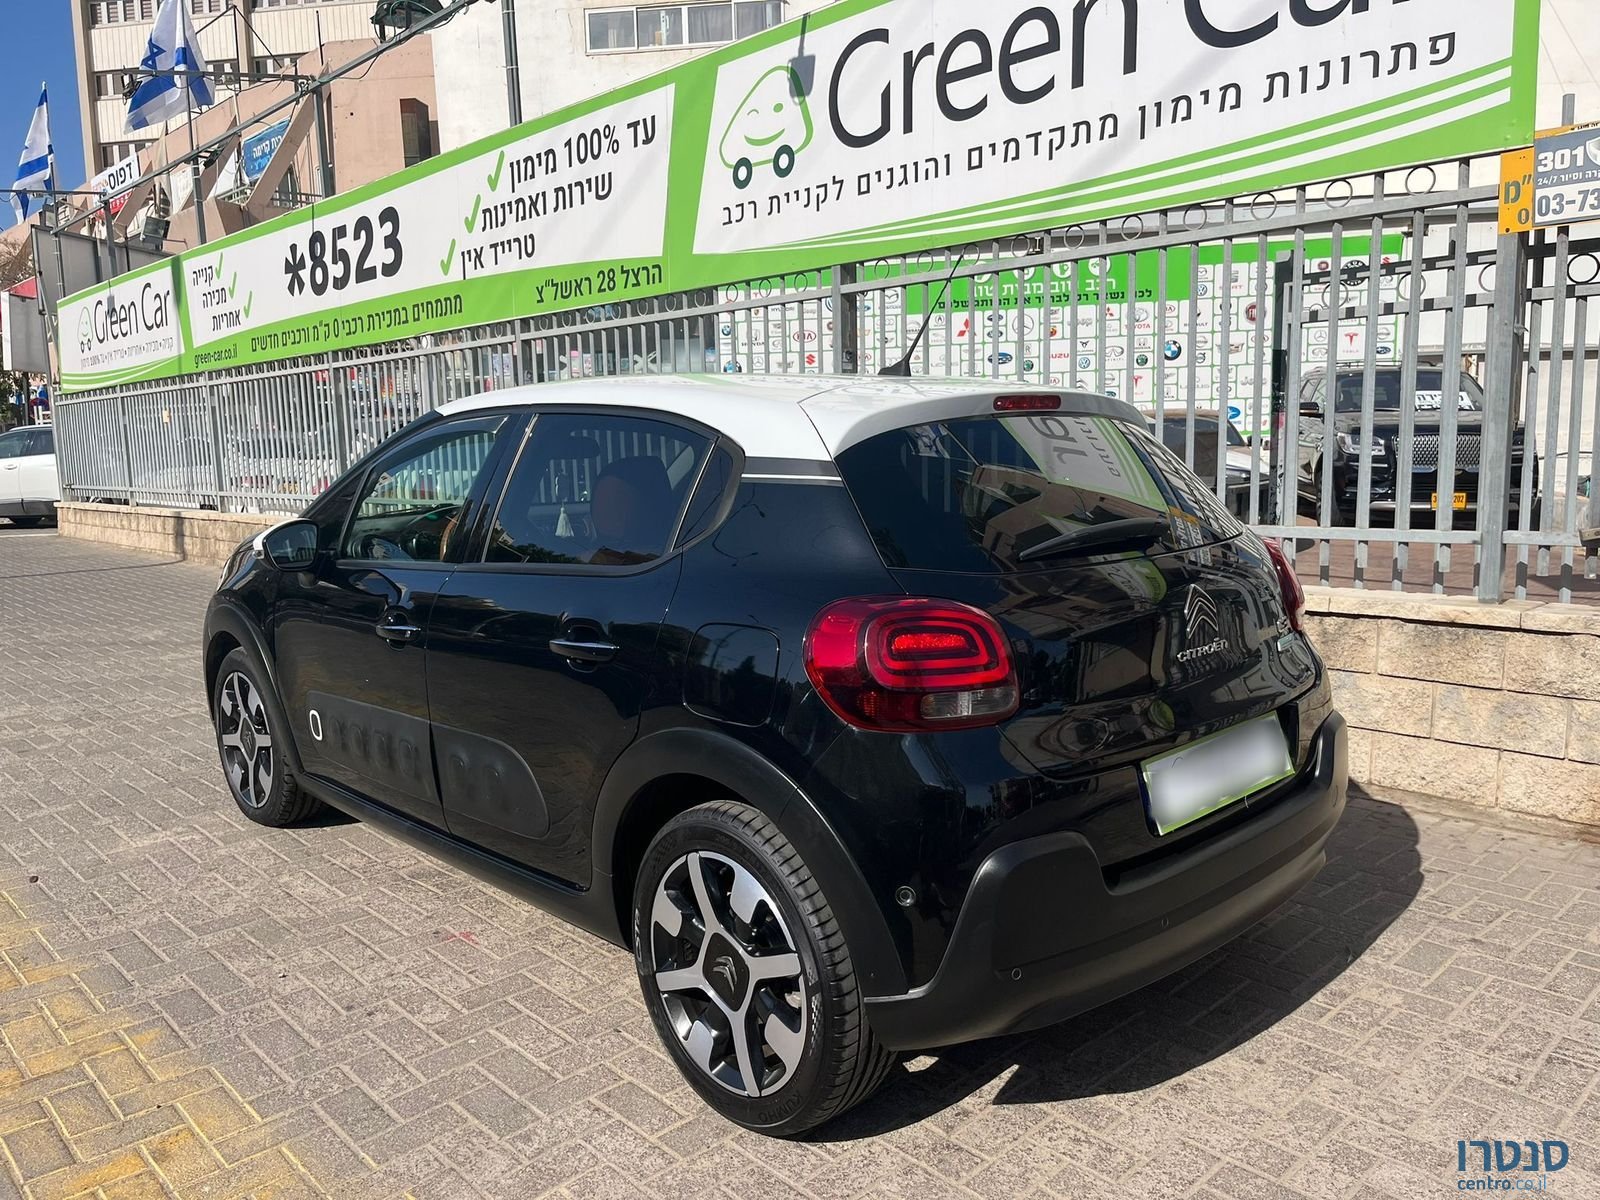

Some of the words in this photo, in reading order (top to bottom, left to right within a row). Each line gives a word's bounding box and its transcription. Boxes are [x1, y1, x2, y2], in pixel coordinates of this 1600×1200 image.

[829, 0, 1138, 148] Green
[1263, 31, 1456, 103] פתרונות
[1139, 82, 1241, 140] מימון
[626, 114, 656, 148] עד
[967, 110, 1118, 171] מתקדמים
[564, 123, 620, 169] 100%
[1537, 145, 1585, 173] 301
[108, 162, 133, 190] דפוס
[509, 147, 557, 193] מימון
[857, 153, 950, 196] והוגנים
[1537, 176, 1558, 186] 24/7
[1560, 172, 1583, 182] וסיור
[553, 171, 613, 214] שירות
[768, 175, 844, 216] לקניית
[481, 190, 547, 232] ואמינות
[721, 199, 758, 227] רכב
[460, 246, 484, 280] אין
[489, 232, 536, 266] טרייד
[192, 265, 214, 287] קנייה
[597, 270, 616, 294] 28
[622, 262, 663, 290] הרצל
[1050, 280, 1079, 292] וב
[1085, 278, 1116, 291] רב
[202, 287, 227, 309] מכירה
[412, 294, 463, 322] מתמחים
[938, 299, 969, 310] שלם
[1093, 291, 1125, 301] נשר
[94, 299, 139, 344] Green
[141, 282, 170, 332] Car
[212, 308, 241, 332] אחריות
[342, 316, 364, 336] רכבי
[367, 306, 409, 331] במכירת
[251, 334, 279, 352] חדשים
[282, 328, 310, 346] ורכבים
[194, 343, 238, 368] green-car.co.il
